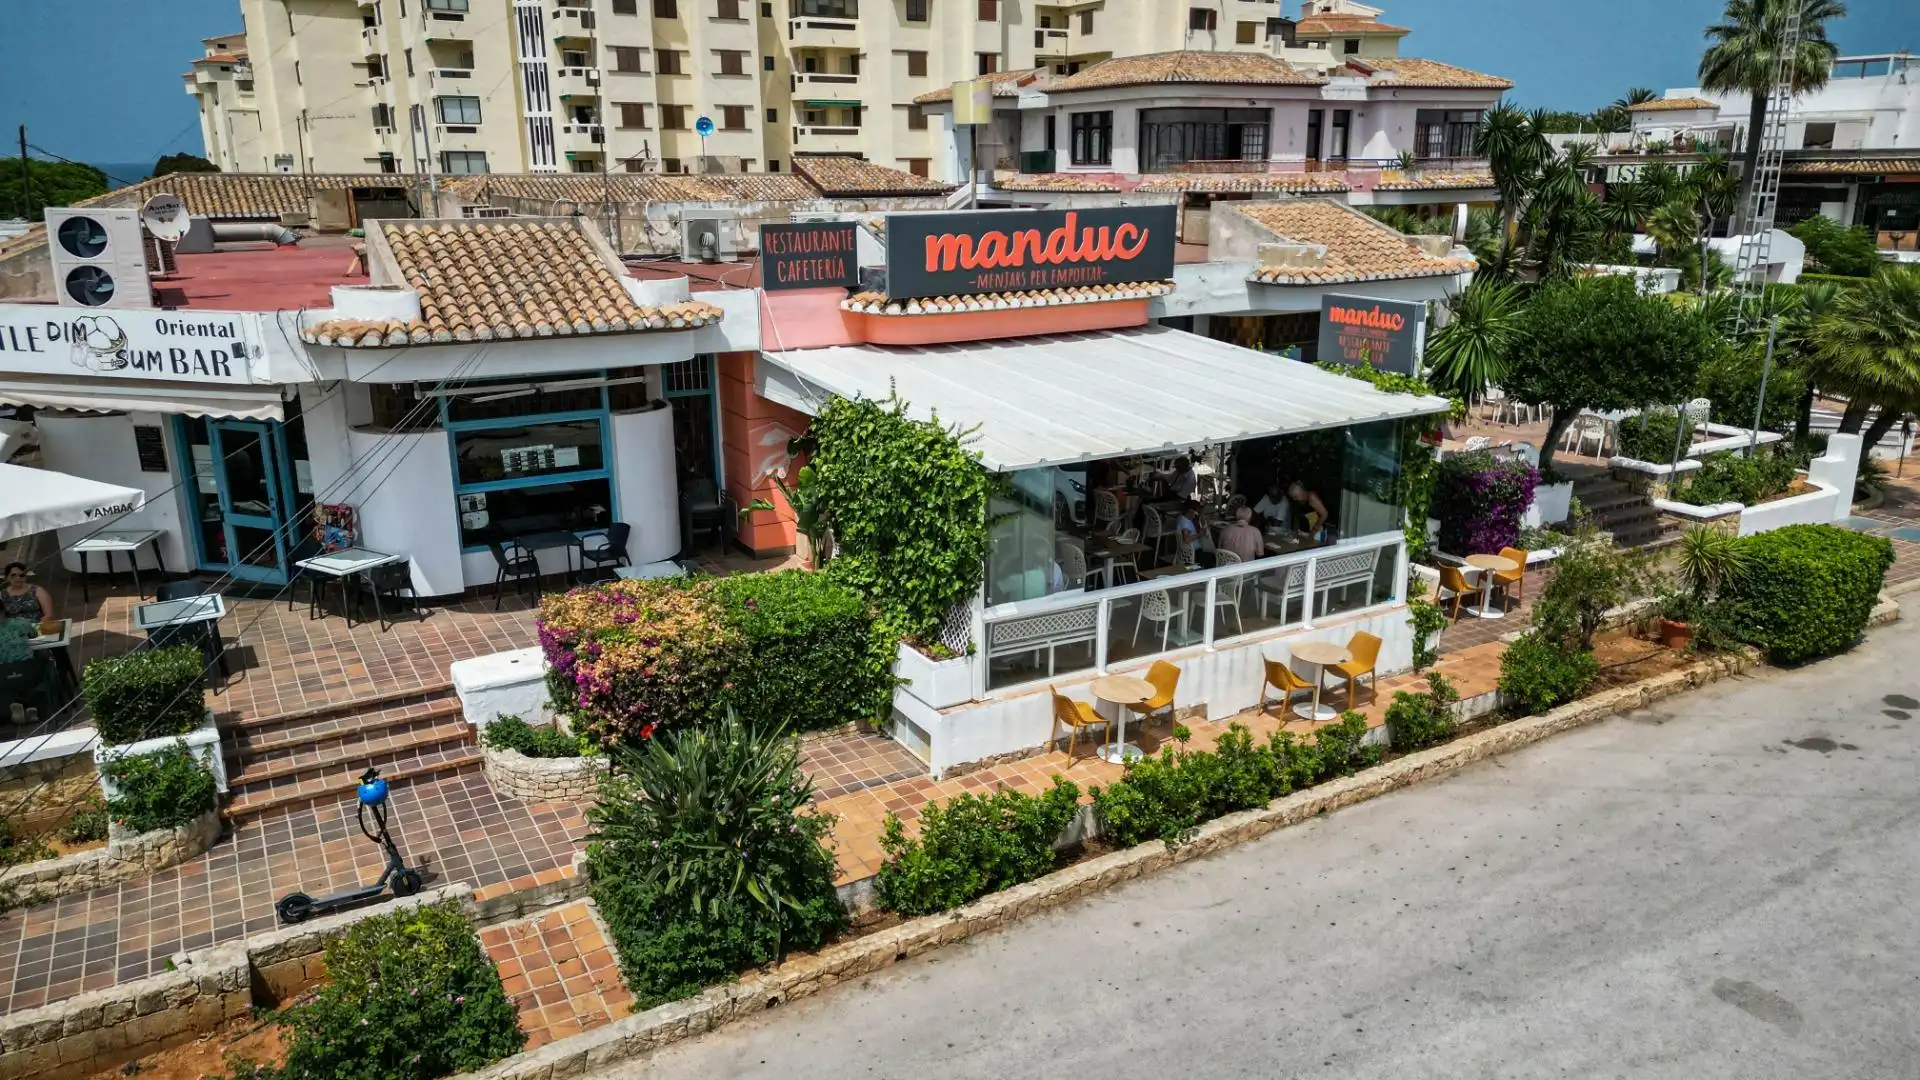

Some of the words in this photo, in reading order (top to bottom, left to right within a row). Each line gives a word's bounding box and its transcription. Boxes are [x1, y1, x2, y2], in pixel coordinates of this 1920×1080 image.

[765, 229, 854, 254] RESTAURANTE
[925, 211, 1149, 272] manduc
[777, 255, 846, 282] CAFETERÍA
[1030, 270, 1047, 286] PER
[155, 318, 235, 338] Oriental
[1329, 304, 1405, 332] manduc
[46, 320, 88, 344] DIM
[115, 348, 163, 373] SUM
[168, 347, 232, 377] BAR
[94, 502, 134, 518] AMBAR
